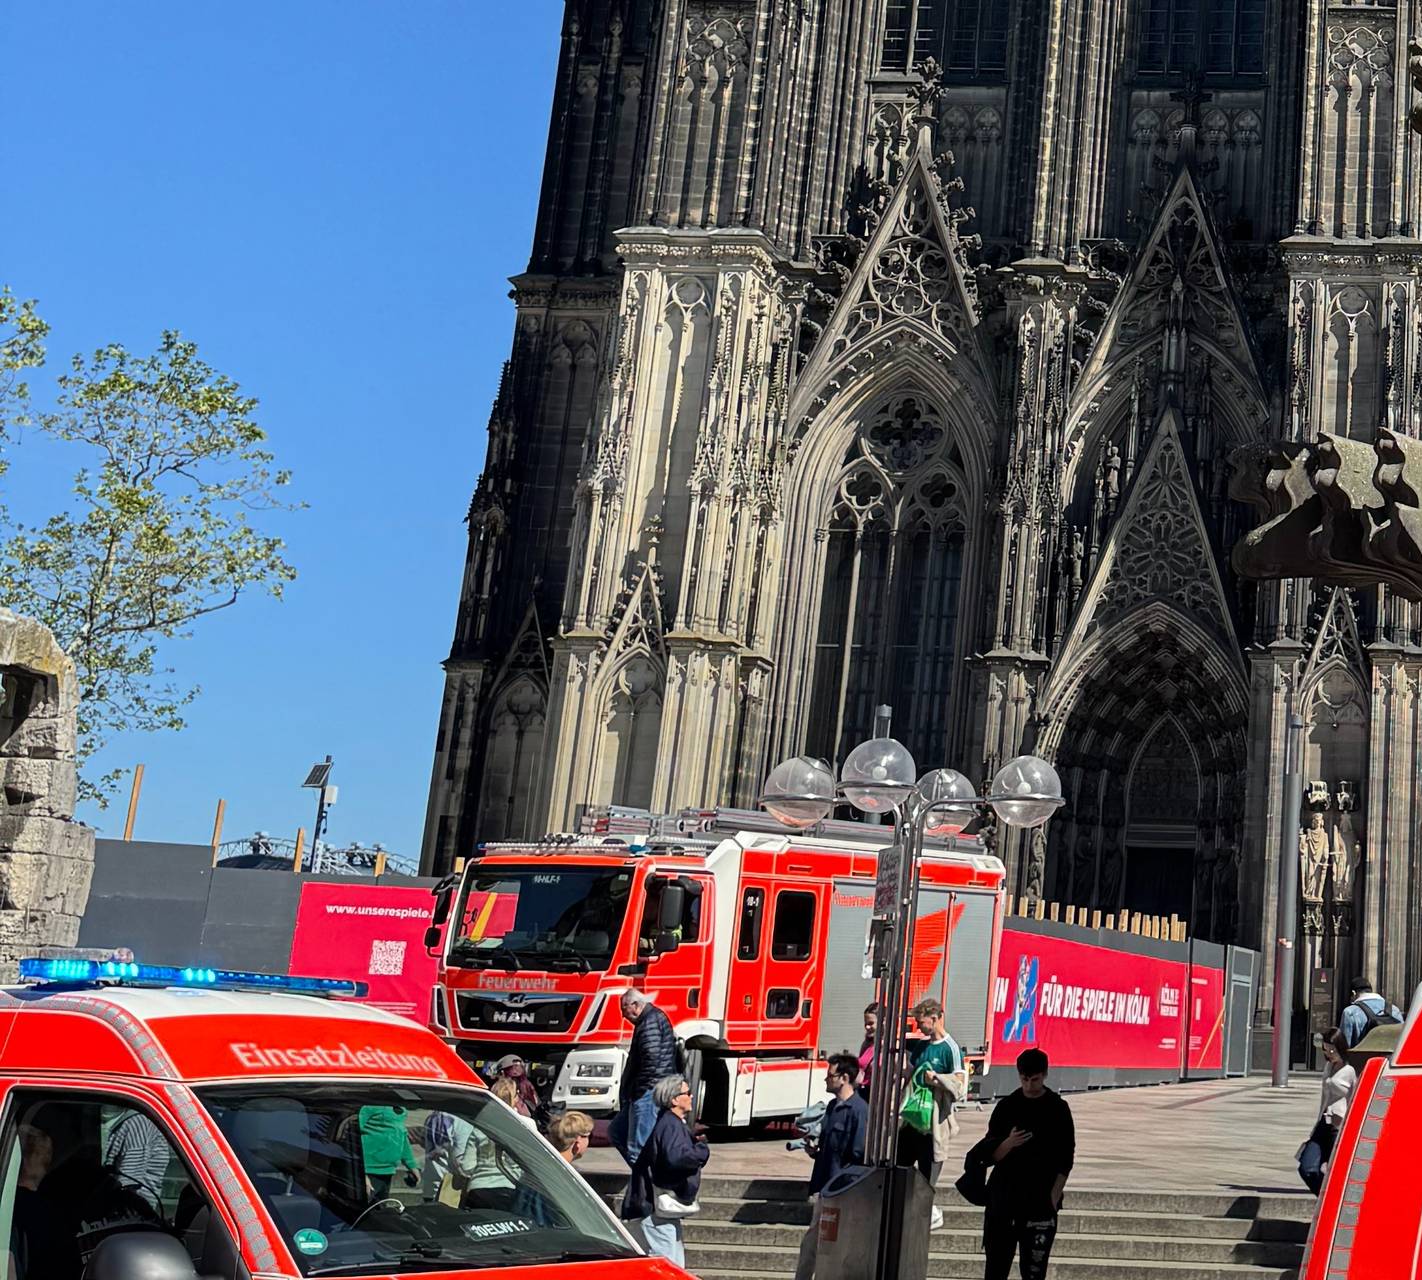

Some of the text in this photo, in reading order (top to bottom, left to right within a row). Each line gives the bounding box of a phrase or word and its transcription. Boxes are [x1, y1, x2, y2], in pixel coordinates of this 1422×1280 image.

[326, 905, 433, 918] www.unserespiele.
[477, 973, 560, 990] Feuerwehr
[993, 977, 1010, 1013] IN
[1039, 975, 1064, 1017] FÜR
[1062, 985, 1083, 1019] DIE
[1081, 988, 1117, 1022] SPIELE
[1114, 992, 1128, 1023] IN
[493, 1011, 536, 1024] MAN
[229, 1043, 448, 1080] Einsatzleitung
